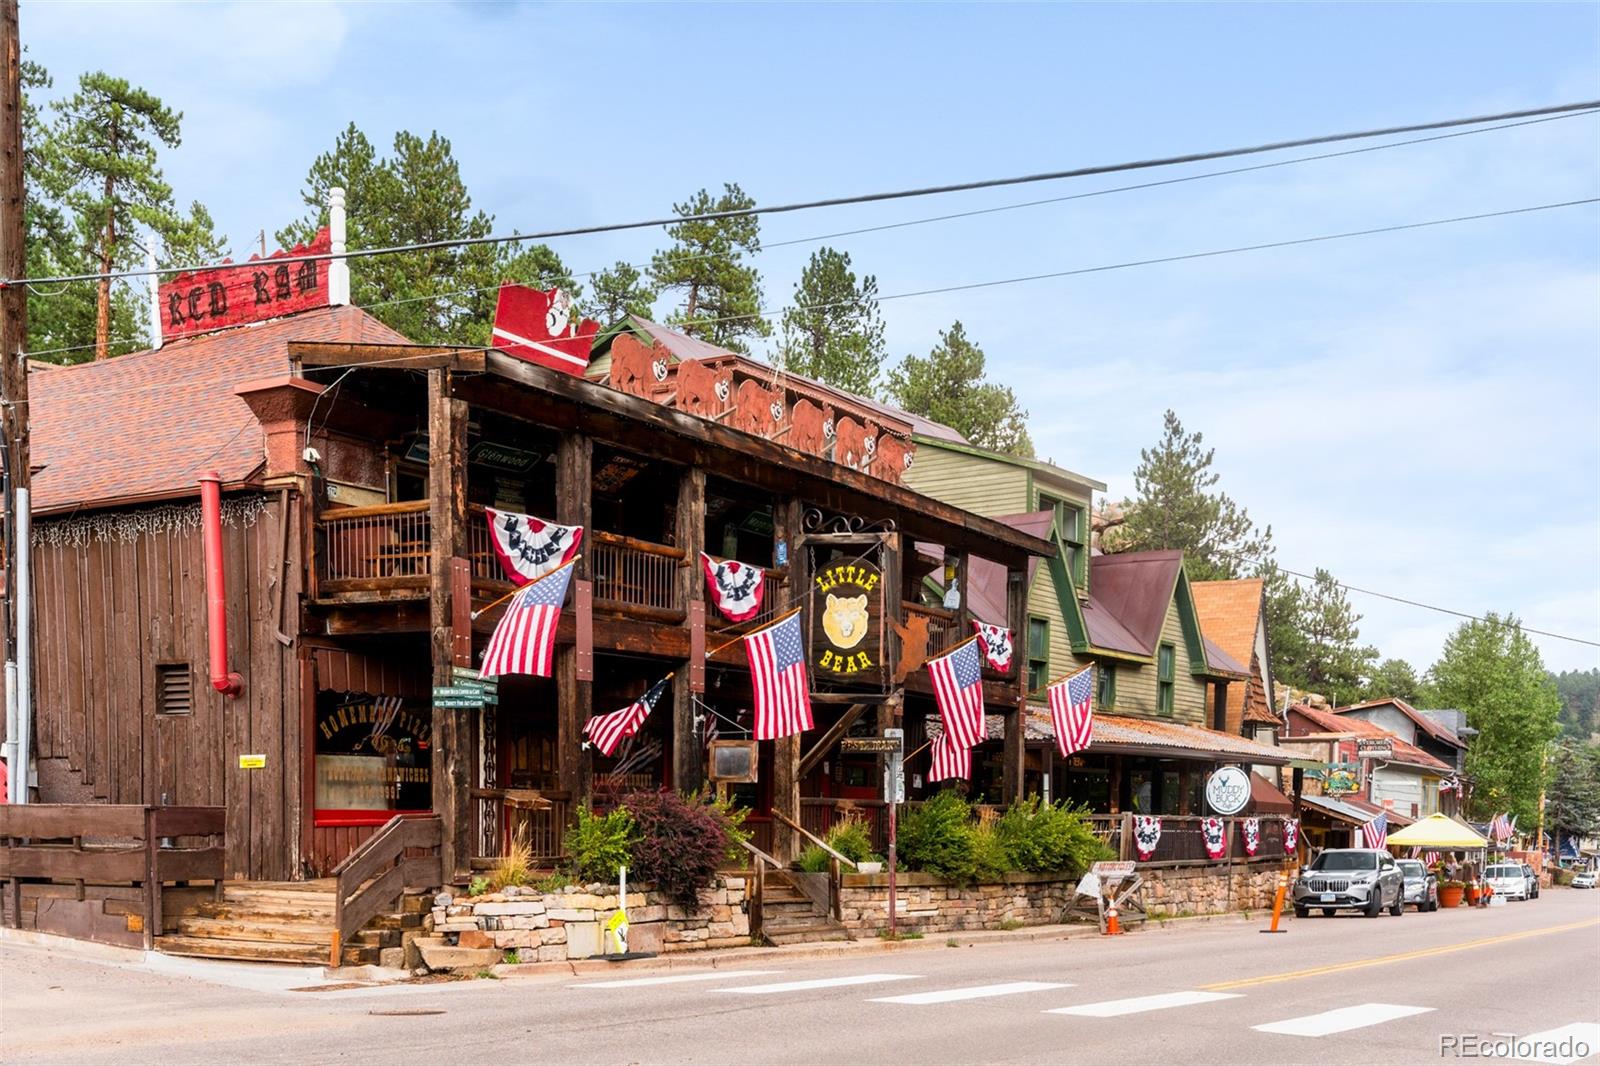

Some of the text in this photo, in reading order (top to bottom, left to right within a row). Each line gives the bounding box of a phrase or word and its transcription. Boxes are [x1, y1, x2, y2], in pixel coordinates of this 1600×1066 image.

[167, 260, 318, 328] RED RAM
[479, 447, 531, 467] Glenwood
[816, 566, 878, 592] LITTLE
[819, 649, 872, 673] BEAR
[1213, 784, 1245, 794] MUDDY
[1216, 793, 1241, 803] BUCK
